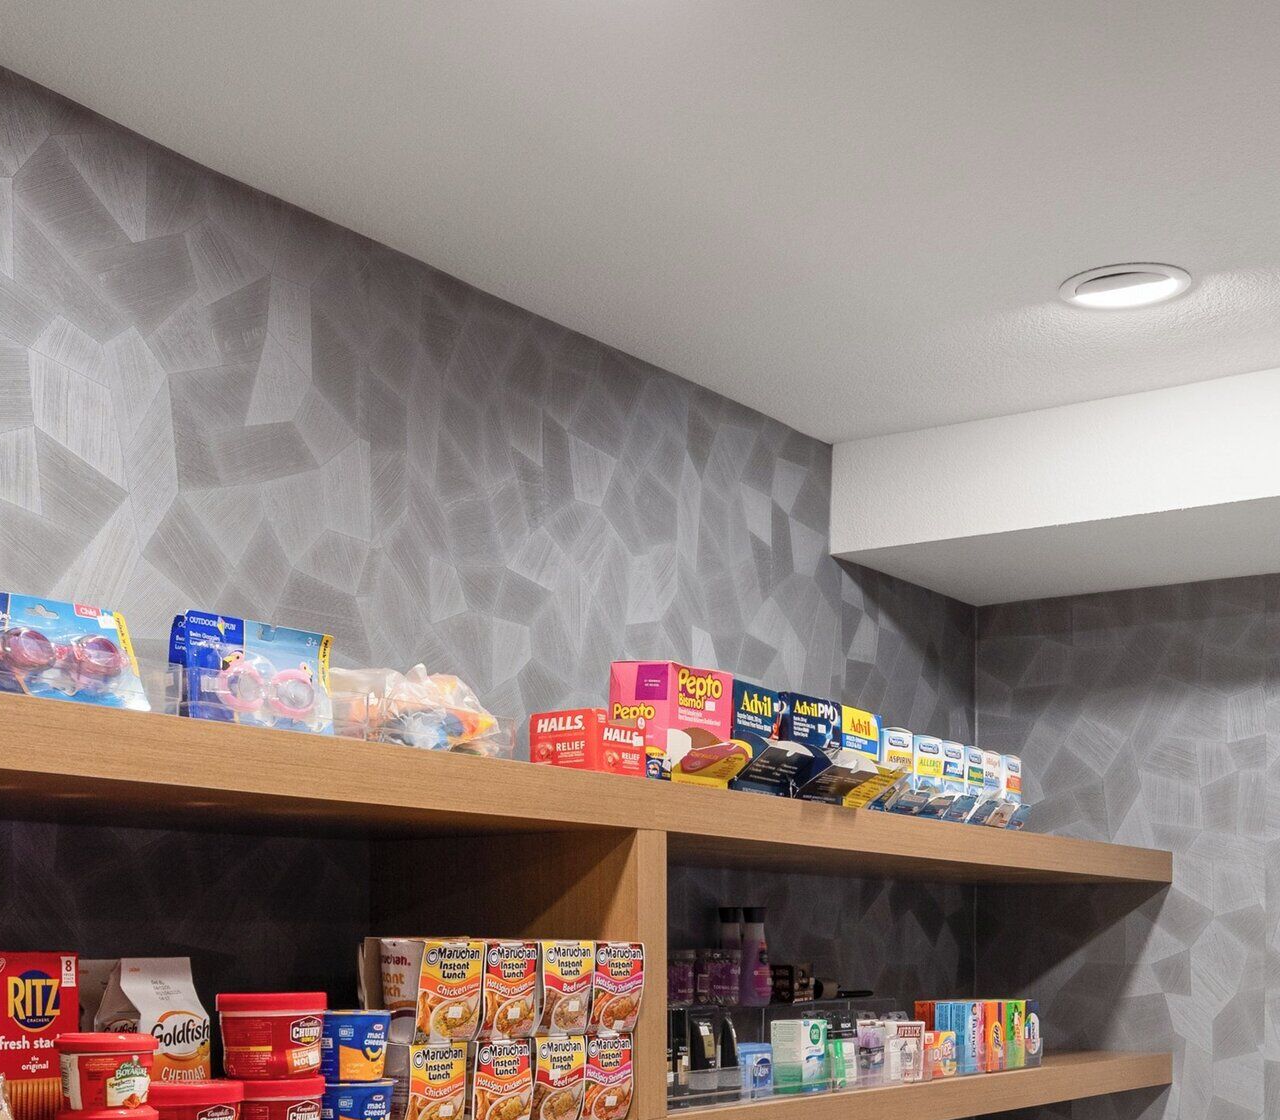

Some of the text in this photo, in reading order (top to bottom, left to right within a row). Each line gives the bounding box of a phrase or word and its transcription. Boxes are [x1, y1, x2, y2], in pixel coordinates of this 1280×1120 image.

[80, 607, 97, 617] Child
[189, 616, 218, 627] OUTDOOR
[306, 637, 318, 647] 3+
[679, 668, 722, 699] Pepto
[678, 693, 705, 710] Bismol
[741, 690, 772, 717] Advil
[613, 702, 655, 721] Pepto
[794, 699, 834, 720] Advil PM
[850, 717, 870, 736] Advil
[556, 741, 585, 752] RELIEF
[621, 752, 640, 761] RELIEF
[888, 755, 912, 766] ASPIRIN
[919, 759, 941, 767] ALLERGY
[437, 947, 480, 960] Maruchan
[498, 947, 536, 960] Maruchan
[554, 946, 591, 959] Maruchan
[606, 946, 643, 960] Maruchan
[65, 960, 72, 972] 8
[440, 960, 470, 970] Instant
[500, 960, 527, 971] Instant
[557, 959, 582, 969] Instant
[608, 959, 633, 969] Instant
[442, 969, 466, 979] Lunch
[503, 969, 524, 978] Lunch
[560, 967, 580, 977] Lunch
[610, 967, 630, 976] Lunch
[436, 983, 467, 995] Chicken
[563, 981, 578, 993] Beef
[8, 976, 60, 1019] RITZ
[150, 1018, 210, 1047] Goldfish
[292, 1026, 320, 1040] CHUNKY
[547, 1040, 582, 1053] Maruchan
[595, 1038, 631, 1051] Maruchan
[422, 1048, 463, 1061] Maruchan
[489, 1043, 528, 1060] Maruchan
[598, 1051, 622, 1061] Instant
[492, 1057, 519, 1068] Instant
[550, 1053, 574, 1063] Instant
[601, 1058, 620, 1068] Lunch
[22, 1060, 49, 1073] original
[425, 1062, 453, 1072] Instant
[495, 1066, 517, 1076] Lunch
[161, 1065, 206, 1081] CHEDDAR
[428, 1070, 450, 1080] Lunch
[553, 1077, 568, 1087] Beef
[423, 1085, 453, 1098] Chicken
